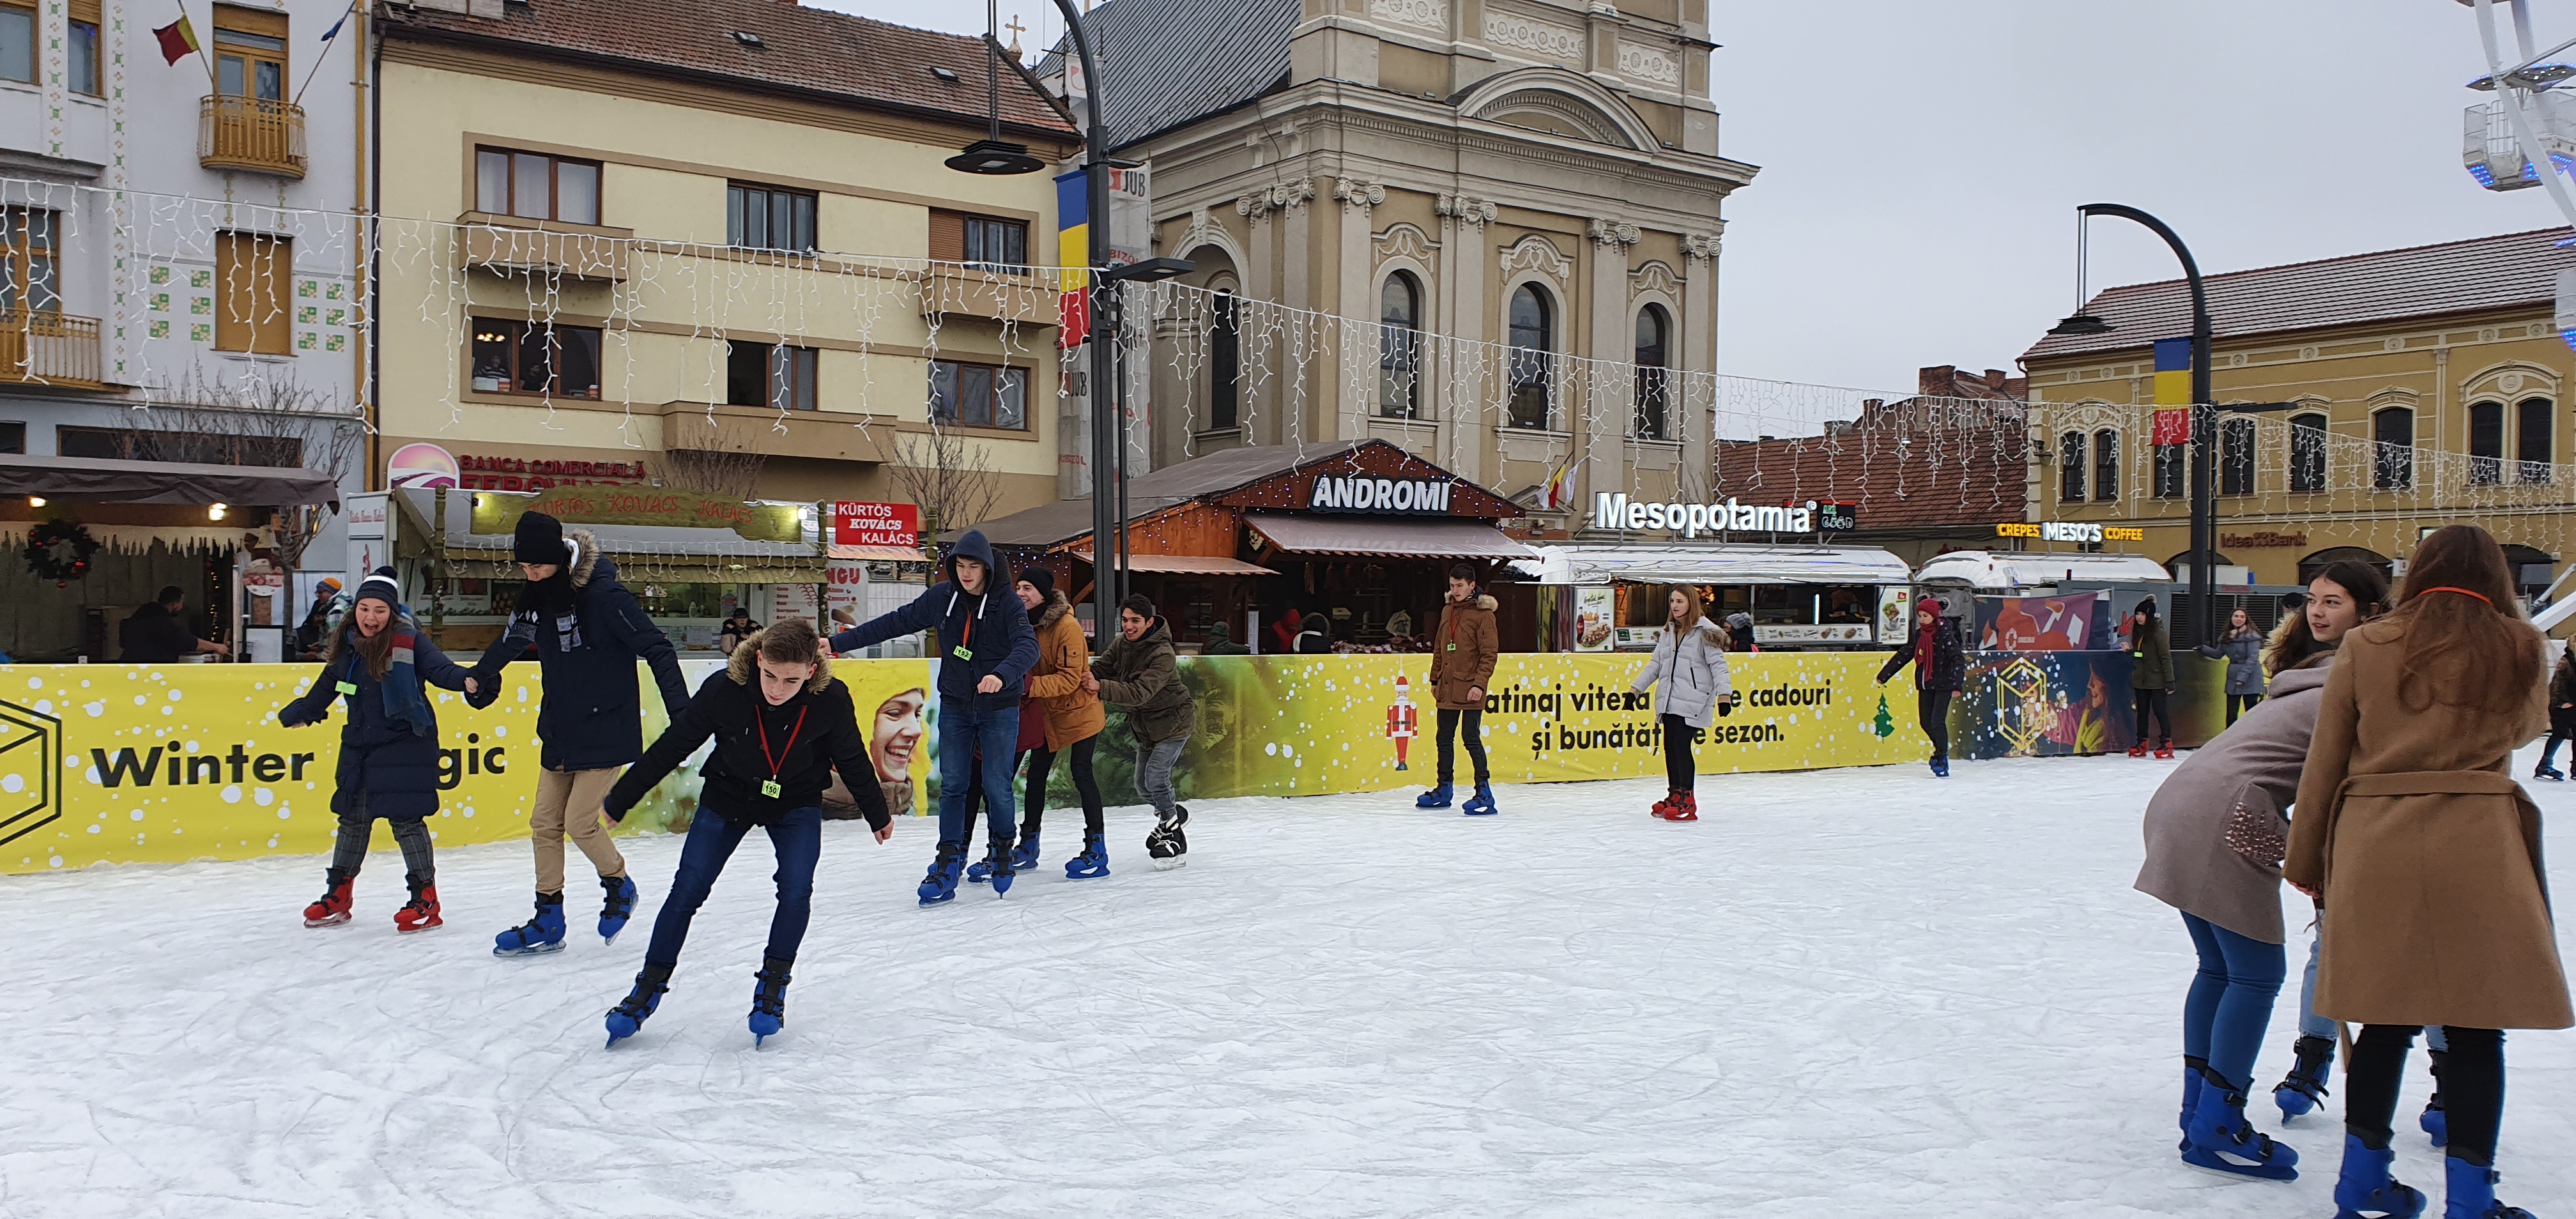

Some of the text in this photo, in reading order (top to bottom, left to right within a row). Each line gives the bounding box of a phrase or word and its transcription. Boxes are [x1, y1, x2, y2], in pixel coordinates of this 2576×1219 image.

[1123, 171, 1146, 197] JUB
[1071, 371, 1087, 396] JUB
[460, 455, 526, 471] BANCA
[1312, 477, 1450, 511] ANDROMI
[838, 502, 892, 517] KÜRTÖS
[1596, 492, 1811, 539] Mesopotamia
[849, 517, 902, 530] KOVÁCS
[1997, 523, 2040, 537] CREPES
[2104, 527, 2143, 540] COFFEE
[861, 531, 914, 545] KALÁCS
[2220, 531, 2307, 548] Idea Bank
[1485, 683, 1561, 721] atinaj
[1749, 678, 1830, 707] cadouri
[1531, 721, 1551, 760] și
[1560, 722, 1662, 756] bunătăț
[1714, 724, 1784, 744] sezon.
[91, 733, 505, 790] Winter gic
[765, 785, 777, 794] 150
